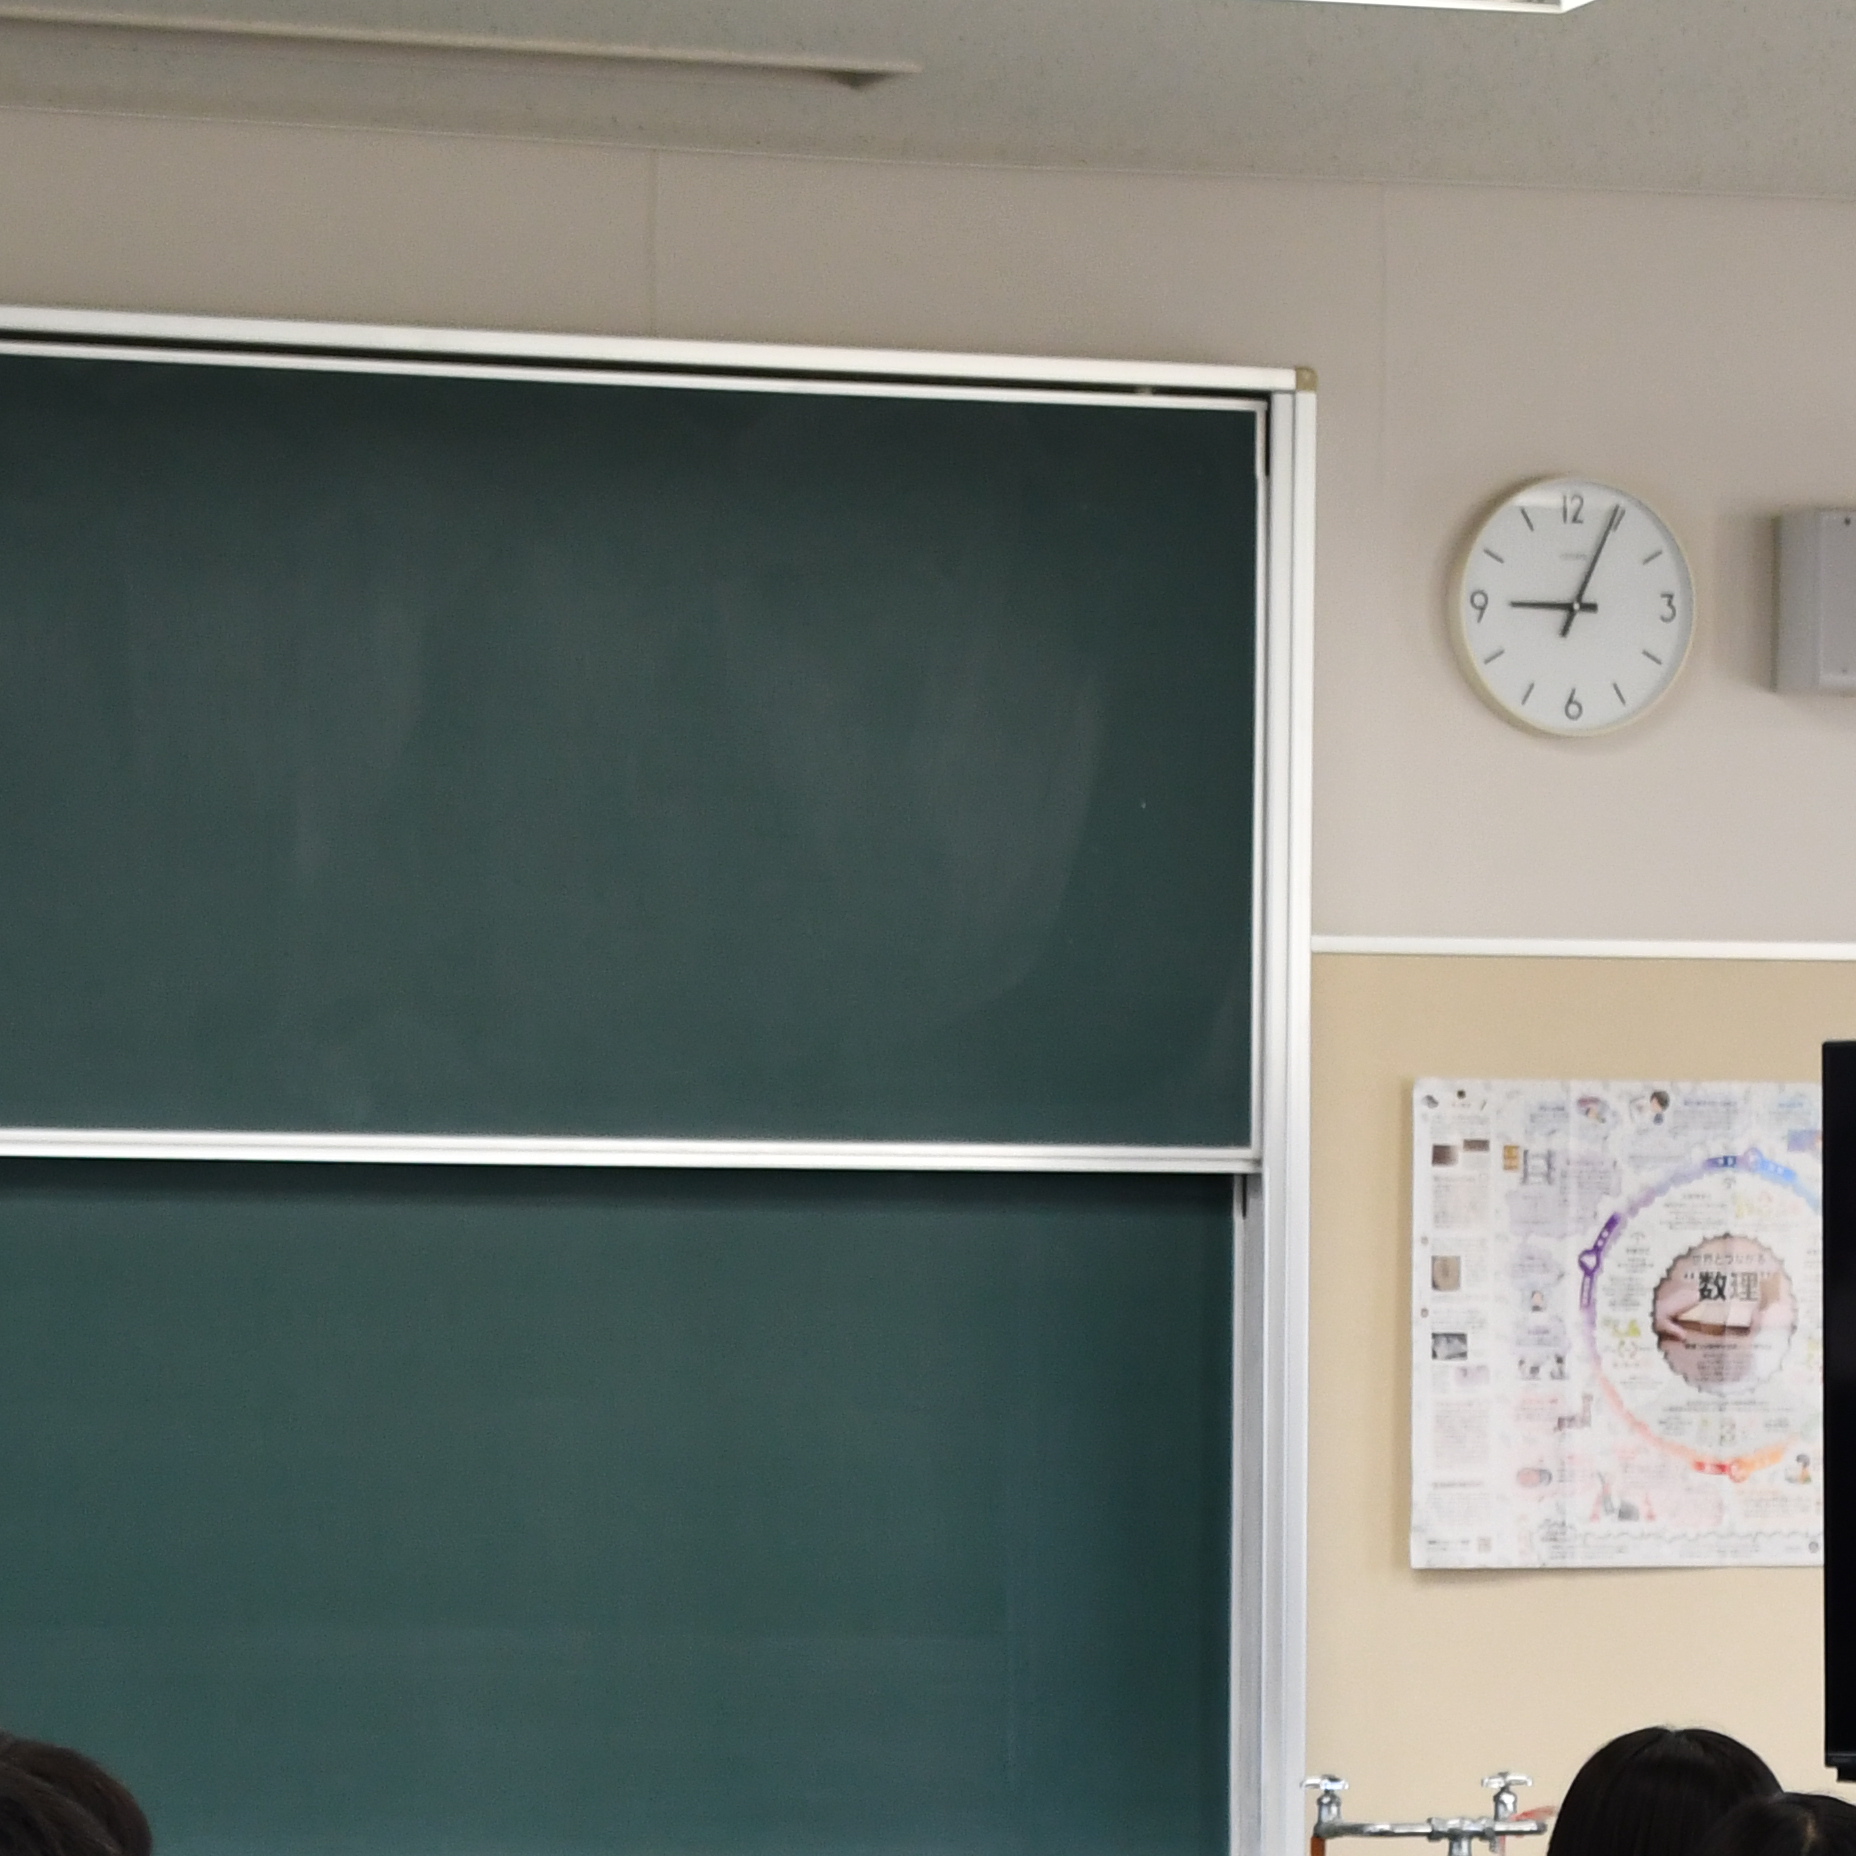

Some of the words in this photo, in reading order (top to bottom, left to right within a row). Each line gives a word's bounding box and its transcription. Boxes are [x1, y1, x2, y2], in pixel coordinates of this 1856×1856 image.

[1561, 494, 1585, 525] 12
[1469, 590, 1489, 624] 9
[1659, 591, 1677, 623] 3
[1564, 687, 1583, 721] 6
